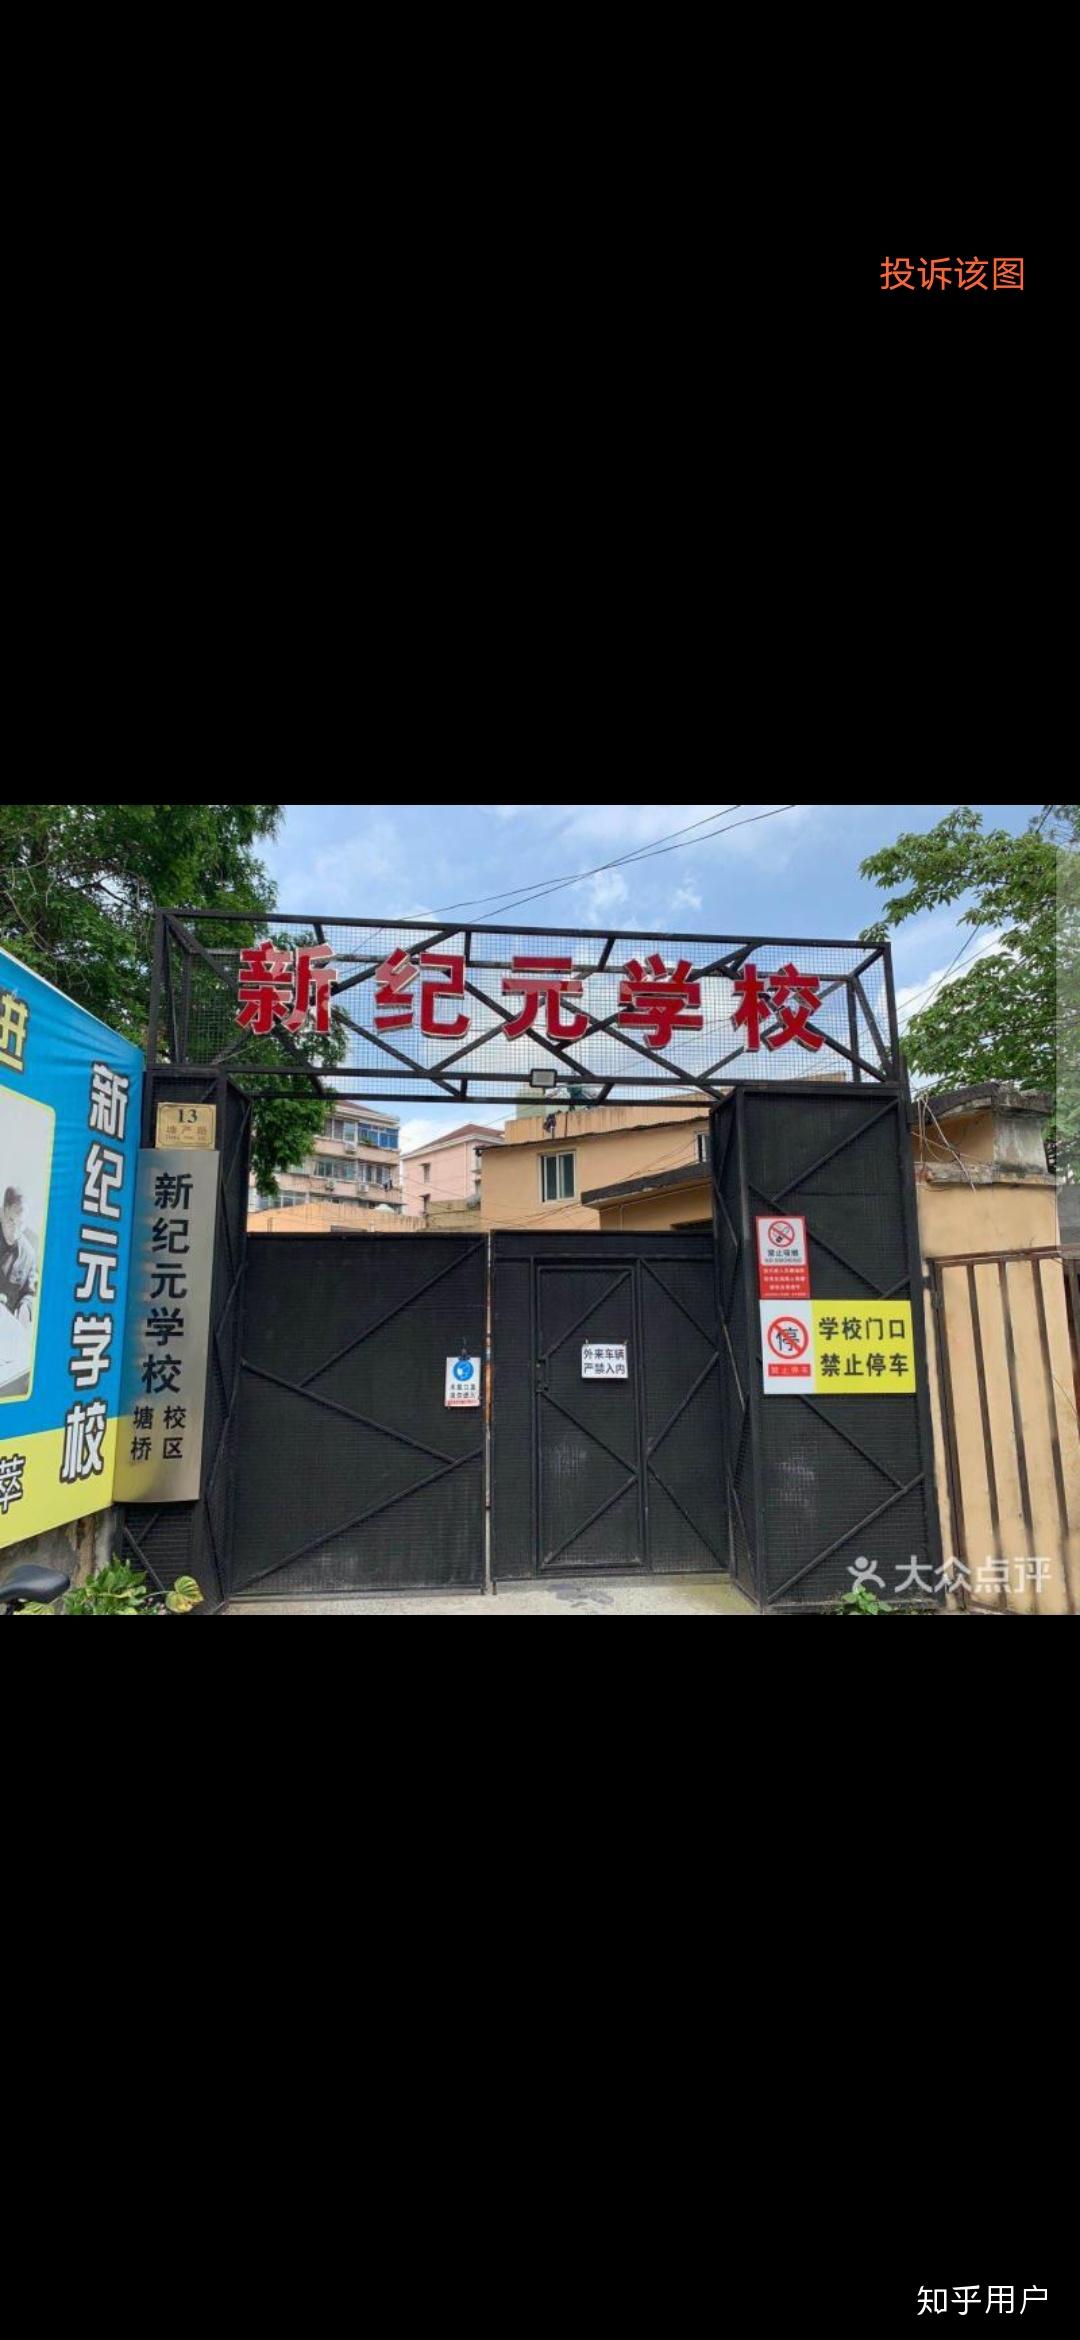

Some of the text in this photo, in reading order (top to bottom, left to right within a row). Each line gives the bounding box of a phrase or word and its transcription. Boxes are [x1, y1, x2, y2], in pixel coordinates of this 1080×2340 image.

[237, 941, 827, 1053] 新纪元学校
[178, 1109, 198, 1123] 13
[60, 1062, 129, 1482] 新纪元学校
[142, 1173, 192, 1394] 新纪元学校
[819, 1316, 905, 1341] 学校门口
[583, 1348, 625, 1360] 外来车辆
[583, 1362, 626, 1374] 严禁入内
[820, 1352, 909, 1378] 禁止停车
[131, 1405, 154, 1461] 塘桥
[163, 1404, 187, 1460] 校区
